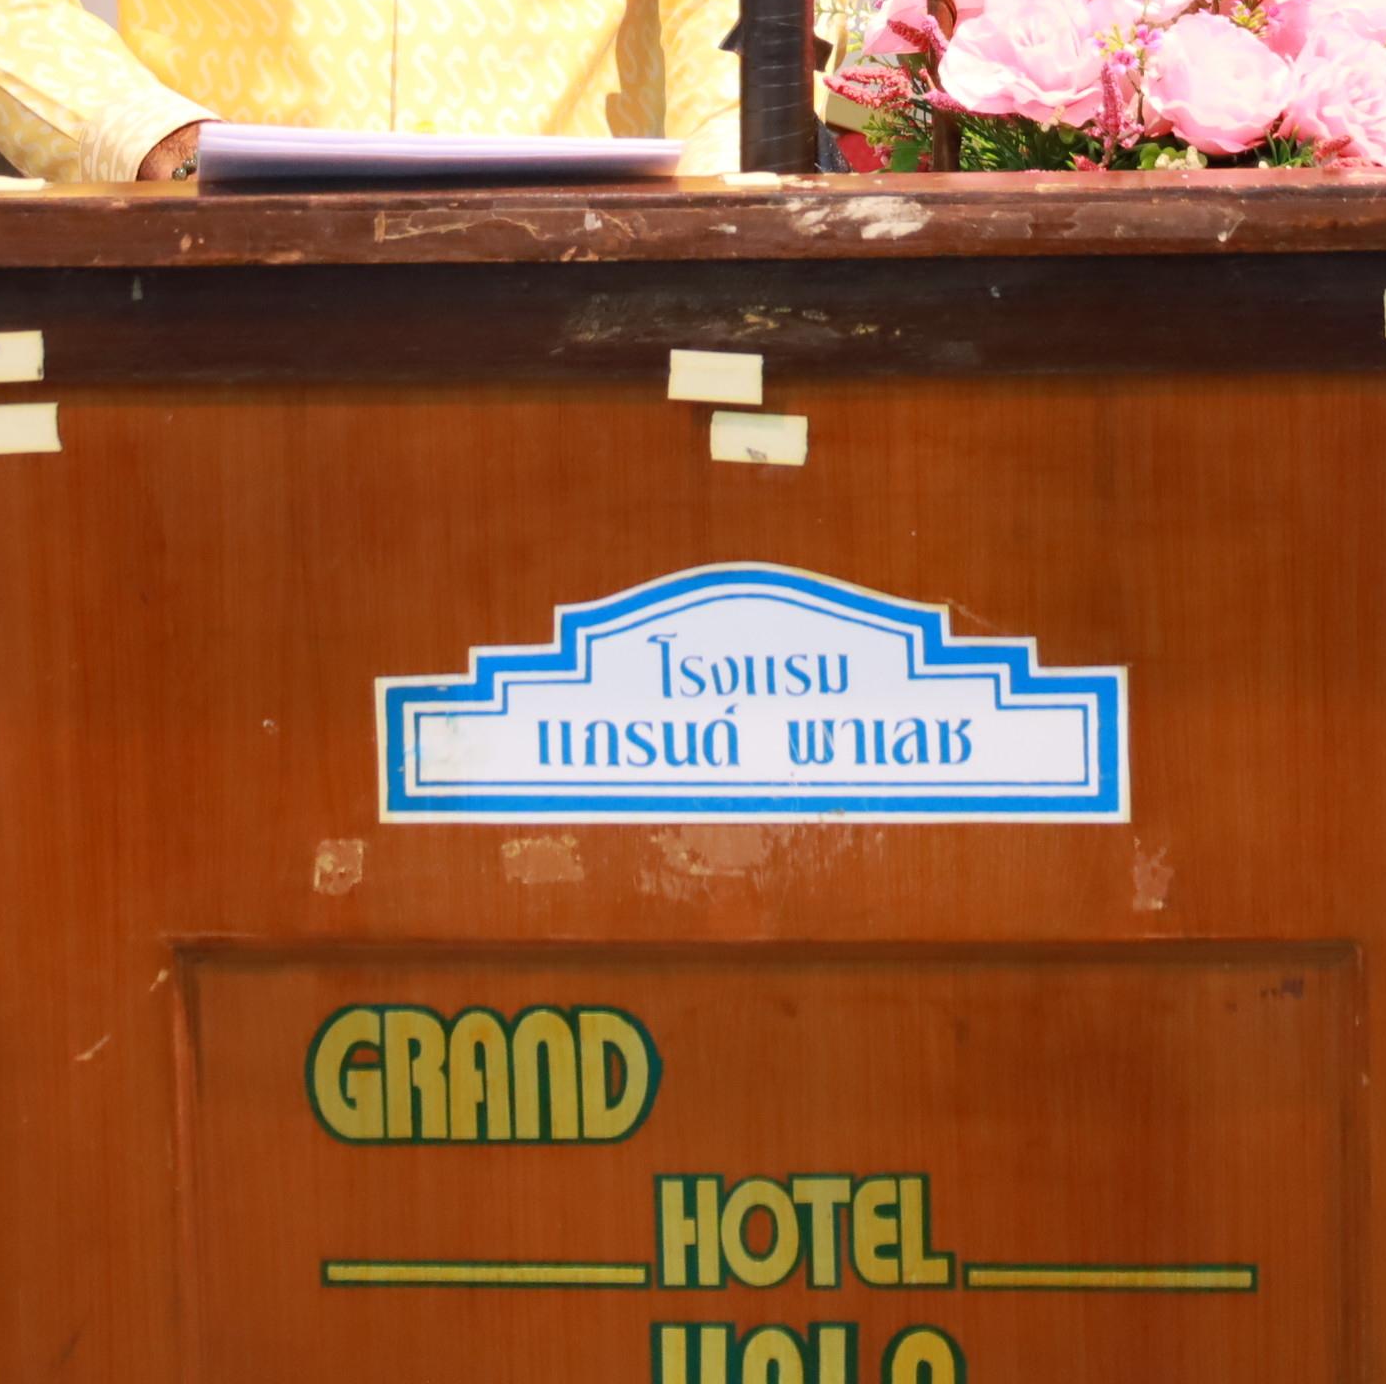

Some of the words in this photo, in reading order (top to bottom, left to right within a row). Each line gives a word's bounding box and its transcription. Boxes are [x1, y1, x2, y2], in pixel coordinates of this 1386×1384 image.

[645, 632, 849, 698] โรงแรม
[537, 703, 740, 767] แกรนด์
[306, 1005, 661, 1145] GRAND
[654, 1175, 955, 1289] HOTEL
